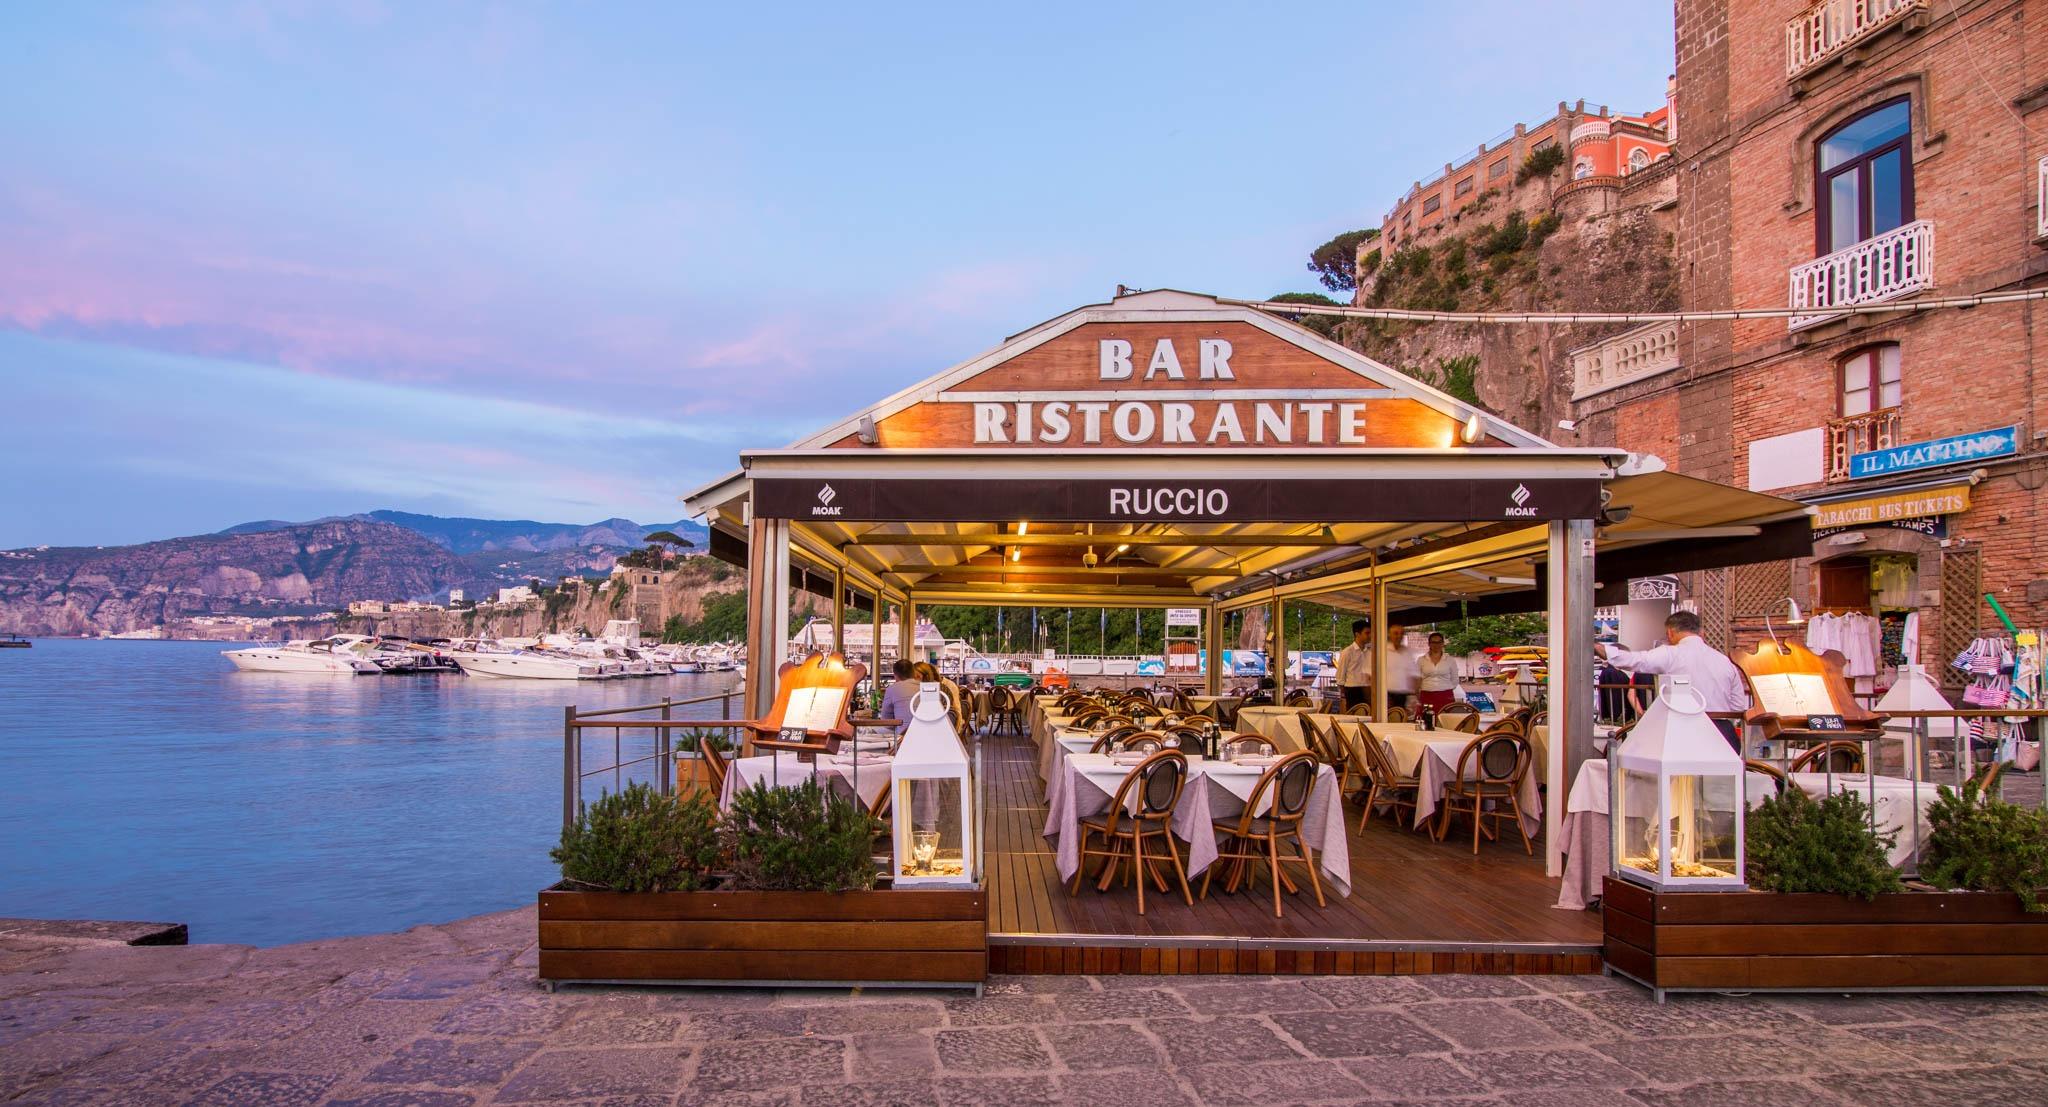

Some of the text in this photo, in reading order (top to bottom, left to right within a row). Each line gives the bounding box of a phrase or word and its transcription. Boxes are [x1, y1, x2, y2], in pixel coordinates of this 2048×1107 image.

[1099, 338, 1236, 381] BAR
[973, 401, 1368, 445] RISTORANTE
[1862, 456, 1884, 473] IL
[812, 506, 842, 516] MOAK
[1109, 488, 1229, 515] RUCCIO
[1505, 507, 1537, 516] MOAK
[1816, 495, 1964, 527] TABACCHI BUS TICKETS
